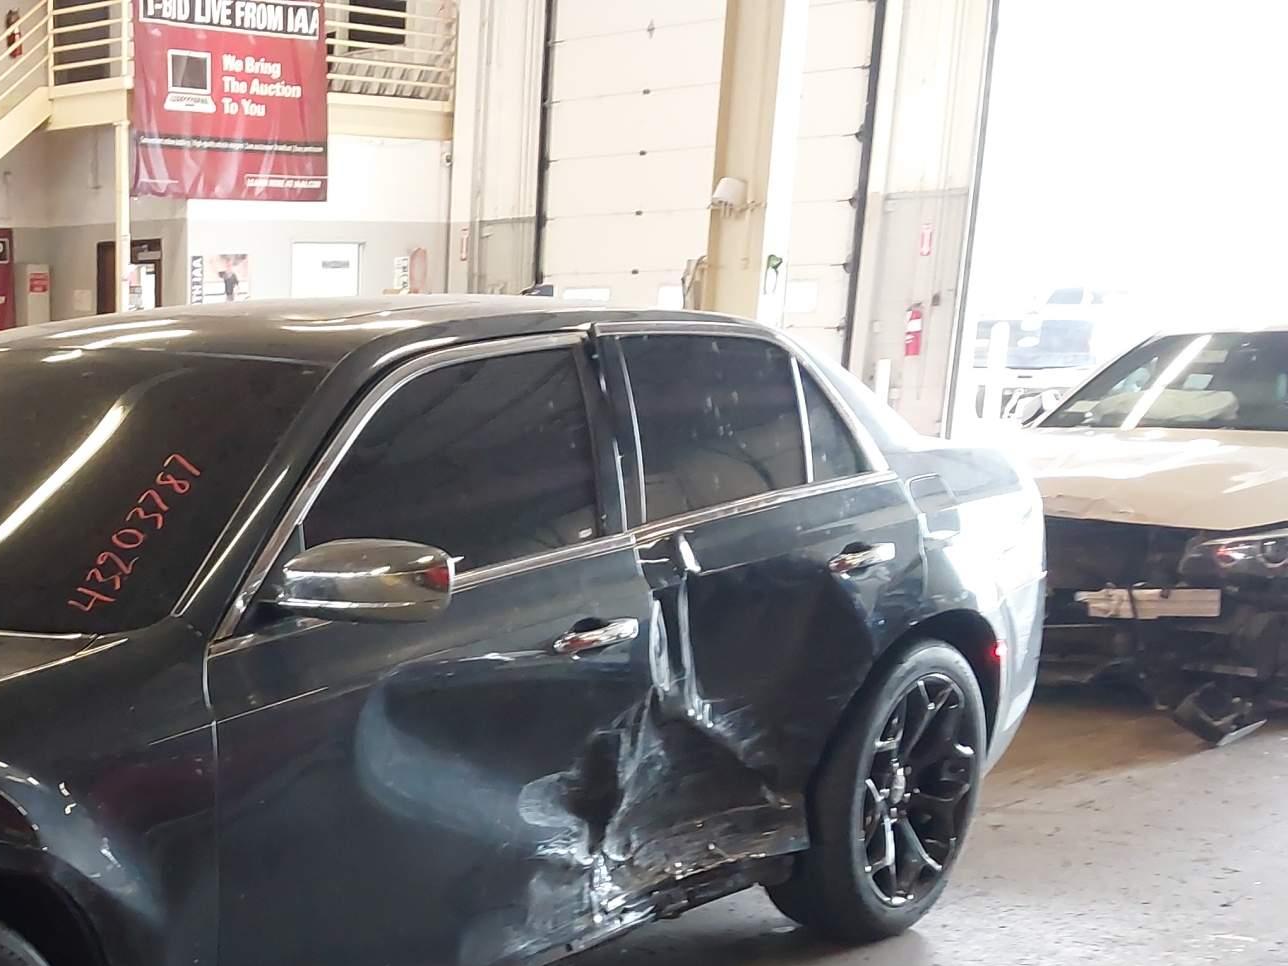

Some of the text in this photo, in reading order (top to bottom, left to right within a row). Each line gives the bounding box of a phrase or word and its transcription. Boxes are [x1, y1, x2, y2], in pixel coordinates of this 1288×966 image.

[195, 0, 232, 26] LIVE
[235, 2, 283, 31] FROM
[287, 8, 319, 34] IAA
[222, 54, 281, 79] We Bring
[222, 76, 302, 98] The Auction
[222, 97, 265, 117] To You
[68, 453, 201, 612] 43203787
